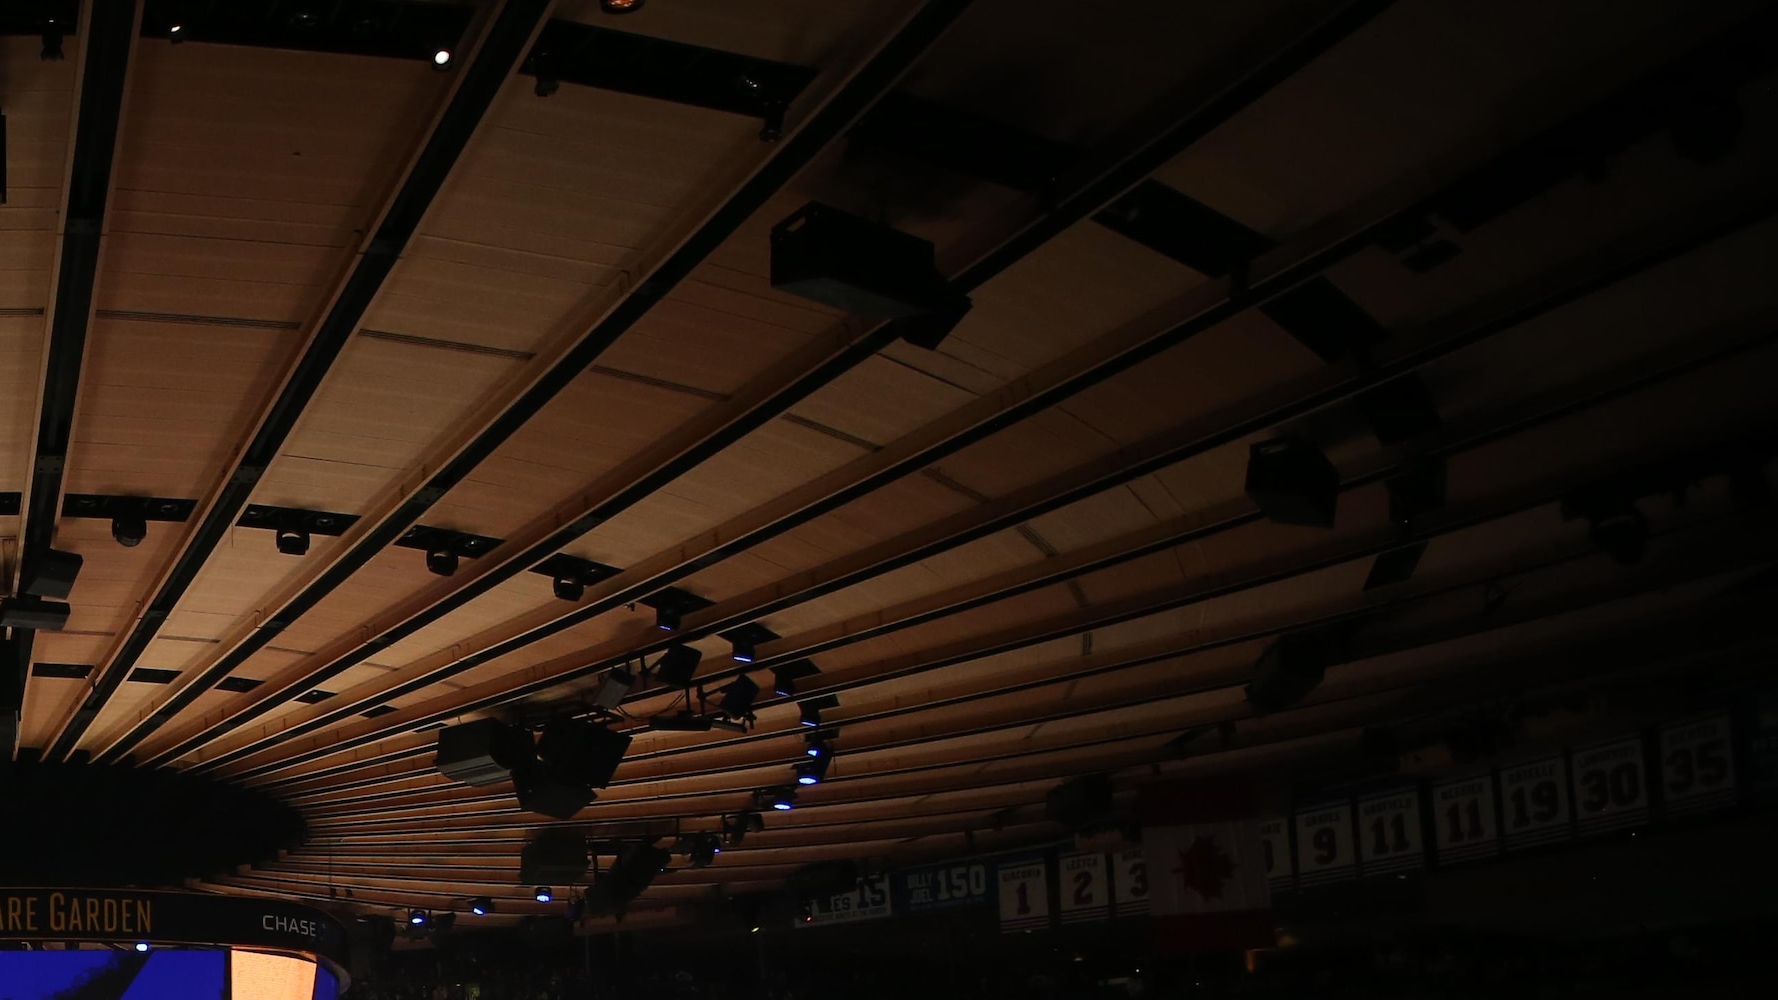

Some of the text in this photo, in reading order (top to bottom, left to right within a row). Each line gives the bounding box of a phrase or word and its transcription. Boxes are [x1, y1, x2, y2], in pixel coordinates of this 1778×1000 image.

[1665, 739, 1727, 793] 35
[1511, 781, 1559, 828] 19
[1581, 762, 1639, 812] 30
[1371, 813, 1410, 855] 11
[1446, 797, 1484, 842] 11
[1313, 827, 1337, 865] 9
[937, 864, 986, 901] 150
[1016, 882, 1031, 915] 1
[1072, 871, 1093, 905] 2
[1129, 862, 1149, 897] 3
[48, 892, 153, 934] GARDEN
[262, 914, 317, 938] CHASE
